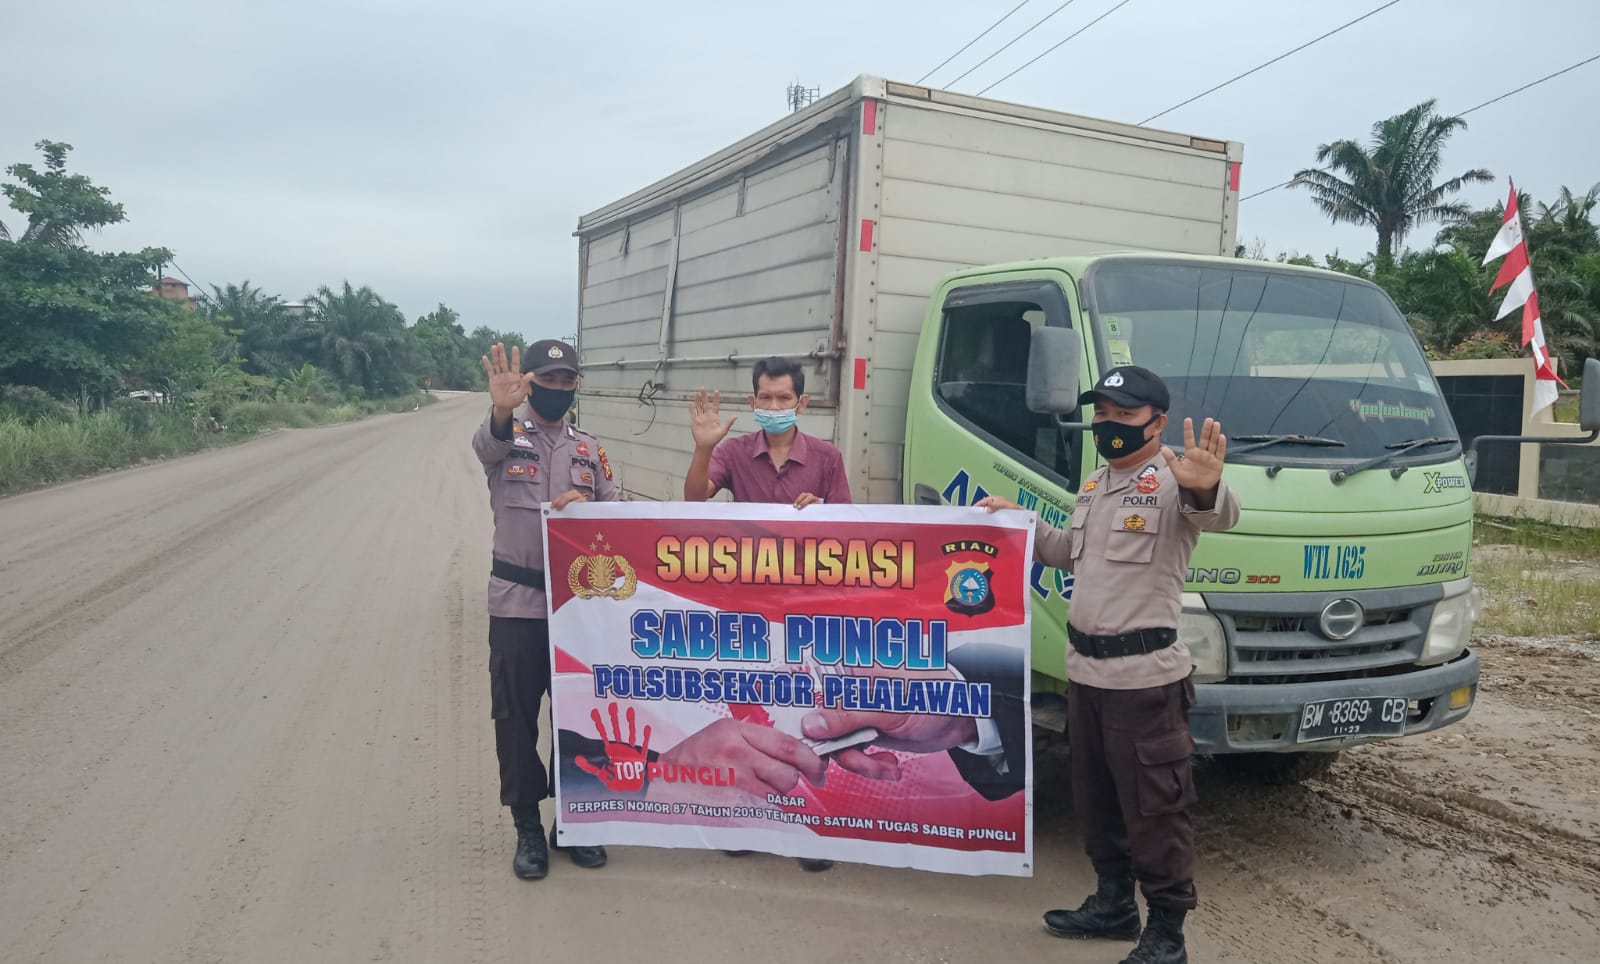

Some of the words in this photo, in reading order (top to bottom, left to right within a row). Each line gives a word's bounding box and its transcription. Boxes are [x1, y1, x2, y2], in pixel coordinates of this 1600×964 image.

[1122, 495, 1158, 505] POLRI
[655, 534, 916, 589] SOSIALISASI
[945, 541, 995, 555] RIAU
[1304, 545, 1330, 579] WTL
[1334, 545, 1366, 579] 1625
[1184, 568, 1241, 584] INO
[1246, 575, 1281, 584] 300
[1416, 561, 1464, 576] DUTRO
[630, 609, 771, 662] SABER
[784, 614, 948, 671] PUNGLI
[593, 665, 815, 708] POLSUBSEKTOR
[823, 673, 992, 718] PELALAWAN
[1302, 704, 1325, 729] BM
[1331, 700, 1370, 724] 8369
[1381, 698, 1406, 723] CB
[605, 761, 645, 781] STOP
[647, 762, 736, 786] PUNGLI
[767, 793, 806, 807] DASAR
[569, 800, 624, 813] PERPRES
[627, 801, 670, 814] NOMOR
[673, 803, 687, 814] 87
[691, 804, 731, 817] TAHUN
[733, 806, 763, 818] 2016
[766, 808, 820, 826] TENTANG
[824, 816, 873, 830] SATUAN
[877, 819, 919, 833] TUGAS
[922, 824, 964, 839] SABER
[968, 829, 1017, 841] PUNGLI
